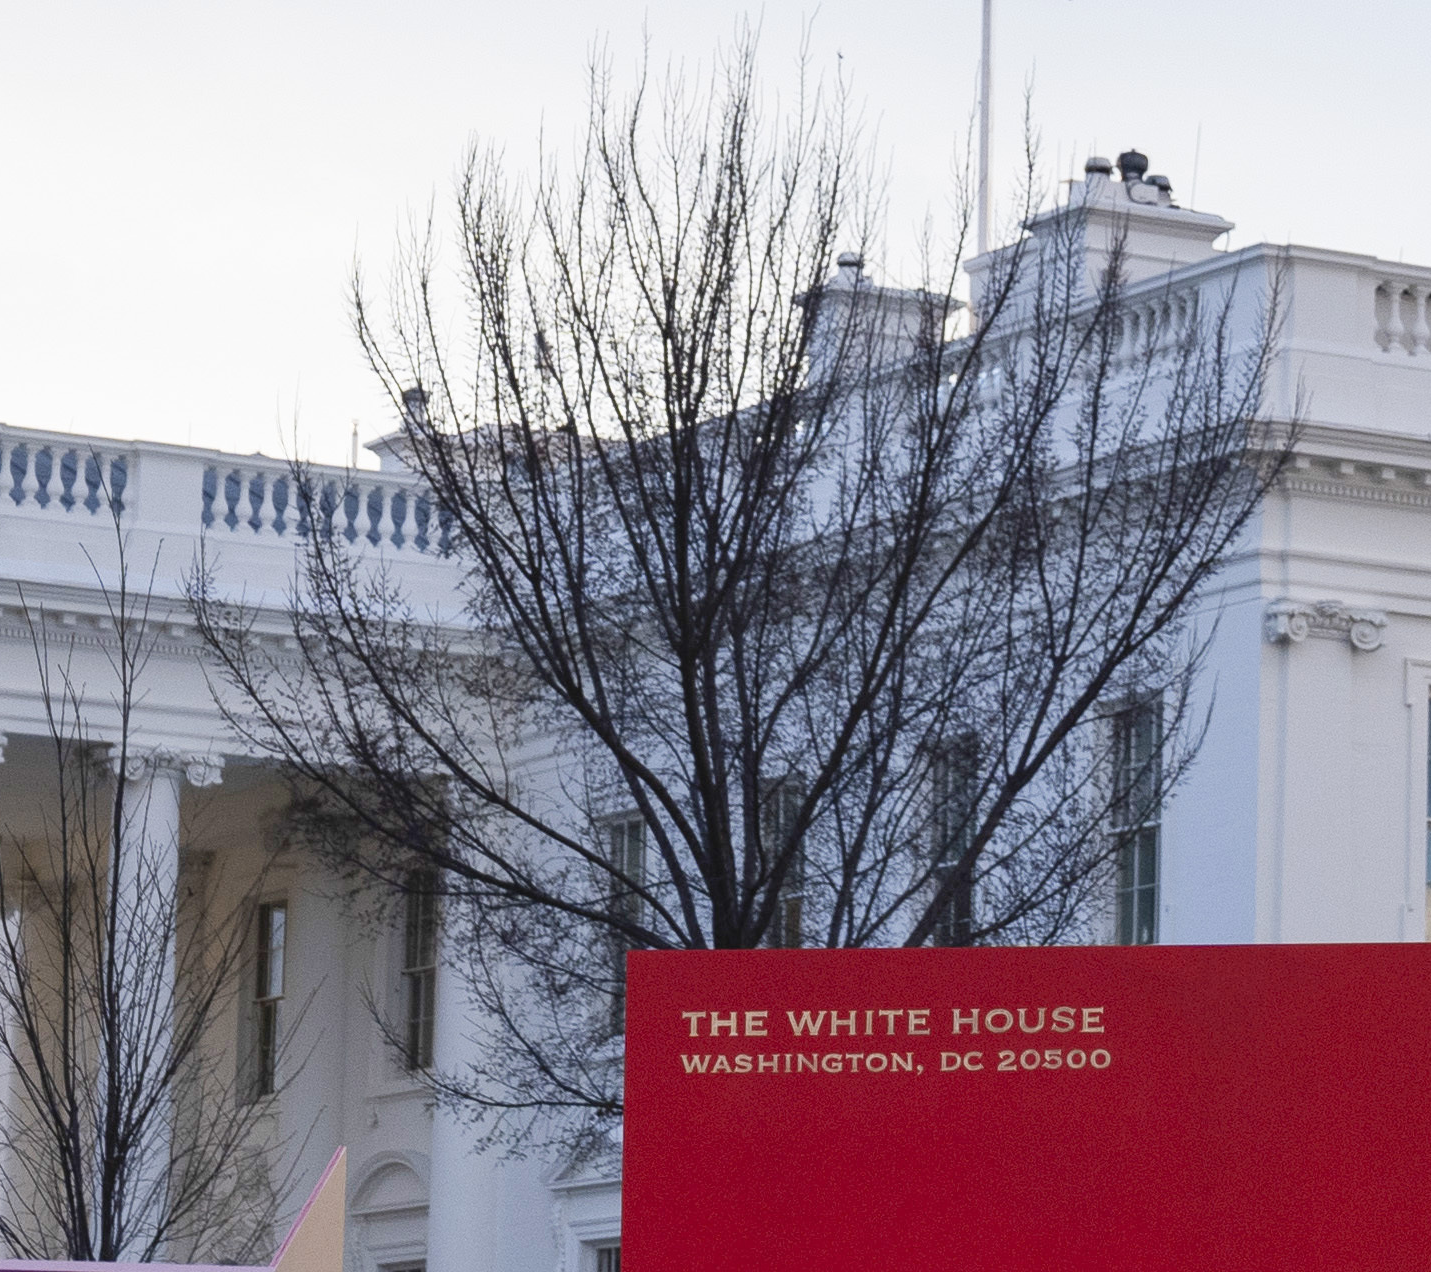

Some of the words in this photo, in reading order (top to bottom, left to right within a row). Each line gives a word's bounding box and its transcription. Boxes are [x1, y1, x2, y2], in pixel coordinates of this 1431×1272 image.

[682, 1010, 769, 1038] THE
[786, 1008, 932, 1037] WHITE
[951, 1006, 1106, 1035] HOUSE
[680, 1051, 924, 1076] WASHINGTON,
[940, 1050, 984, 1072] DC
[997, 1048, 1112, 1072] 20500
